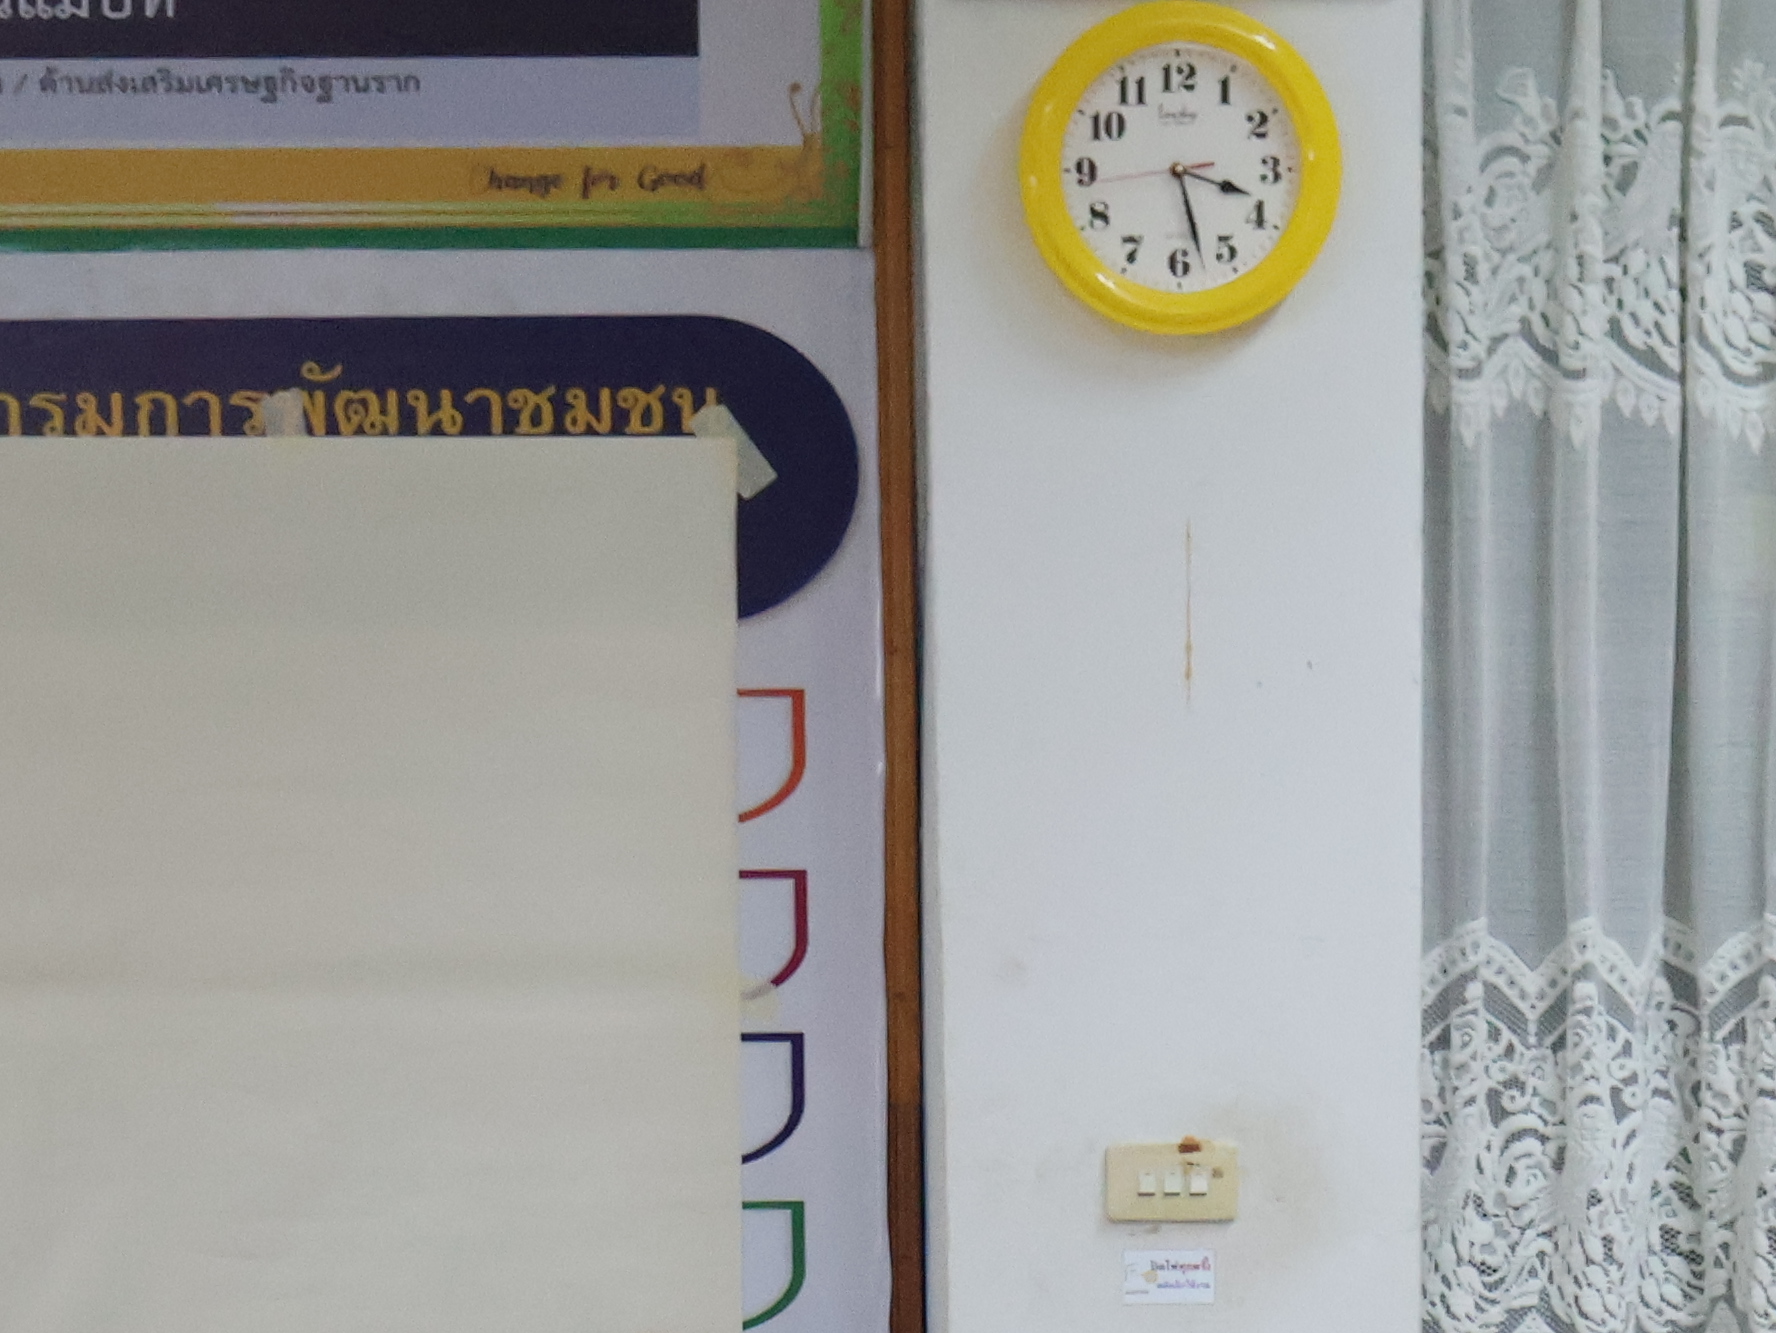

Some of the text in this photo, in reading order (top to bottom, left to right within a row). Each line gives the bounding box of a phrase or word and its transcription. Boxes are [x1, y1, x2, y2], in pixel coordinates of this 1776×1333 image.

[1117, 75, 1148, 106] 11
[1161, 63, 1197, 93] 12
[1218, 75, 1232, 106] 1
[1090, 111, 1127, 141] 10
[1247, 110, 1270, 140] 2
[1074, 157, 1097, 187] 9
[1260, 156, 1282, 185] 3
[1089, 201, 1110, 231] 8
[1245, 200, 1266, 230] 4
[1121, 235, 1144, 264] 7
[1168, 249, 1191, 278] 6
[1216, 235, 1238, 264] 5
